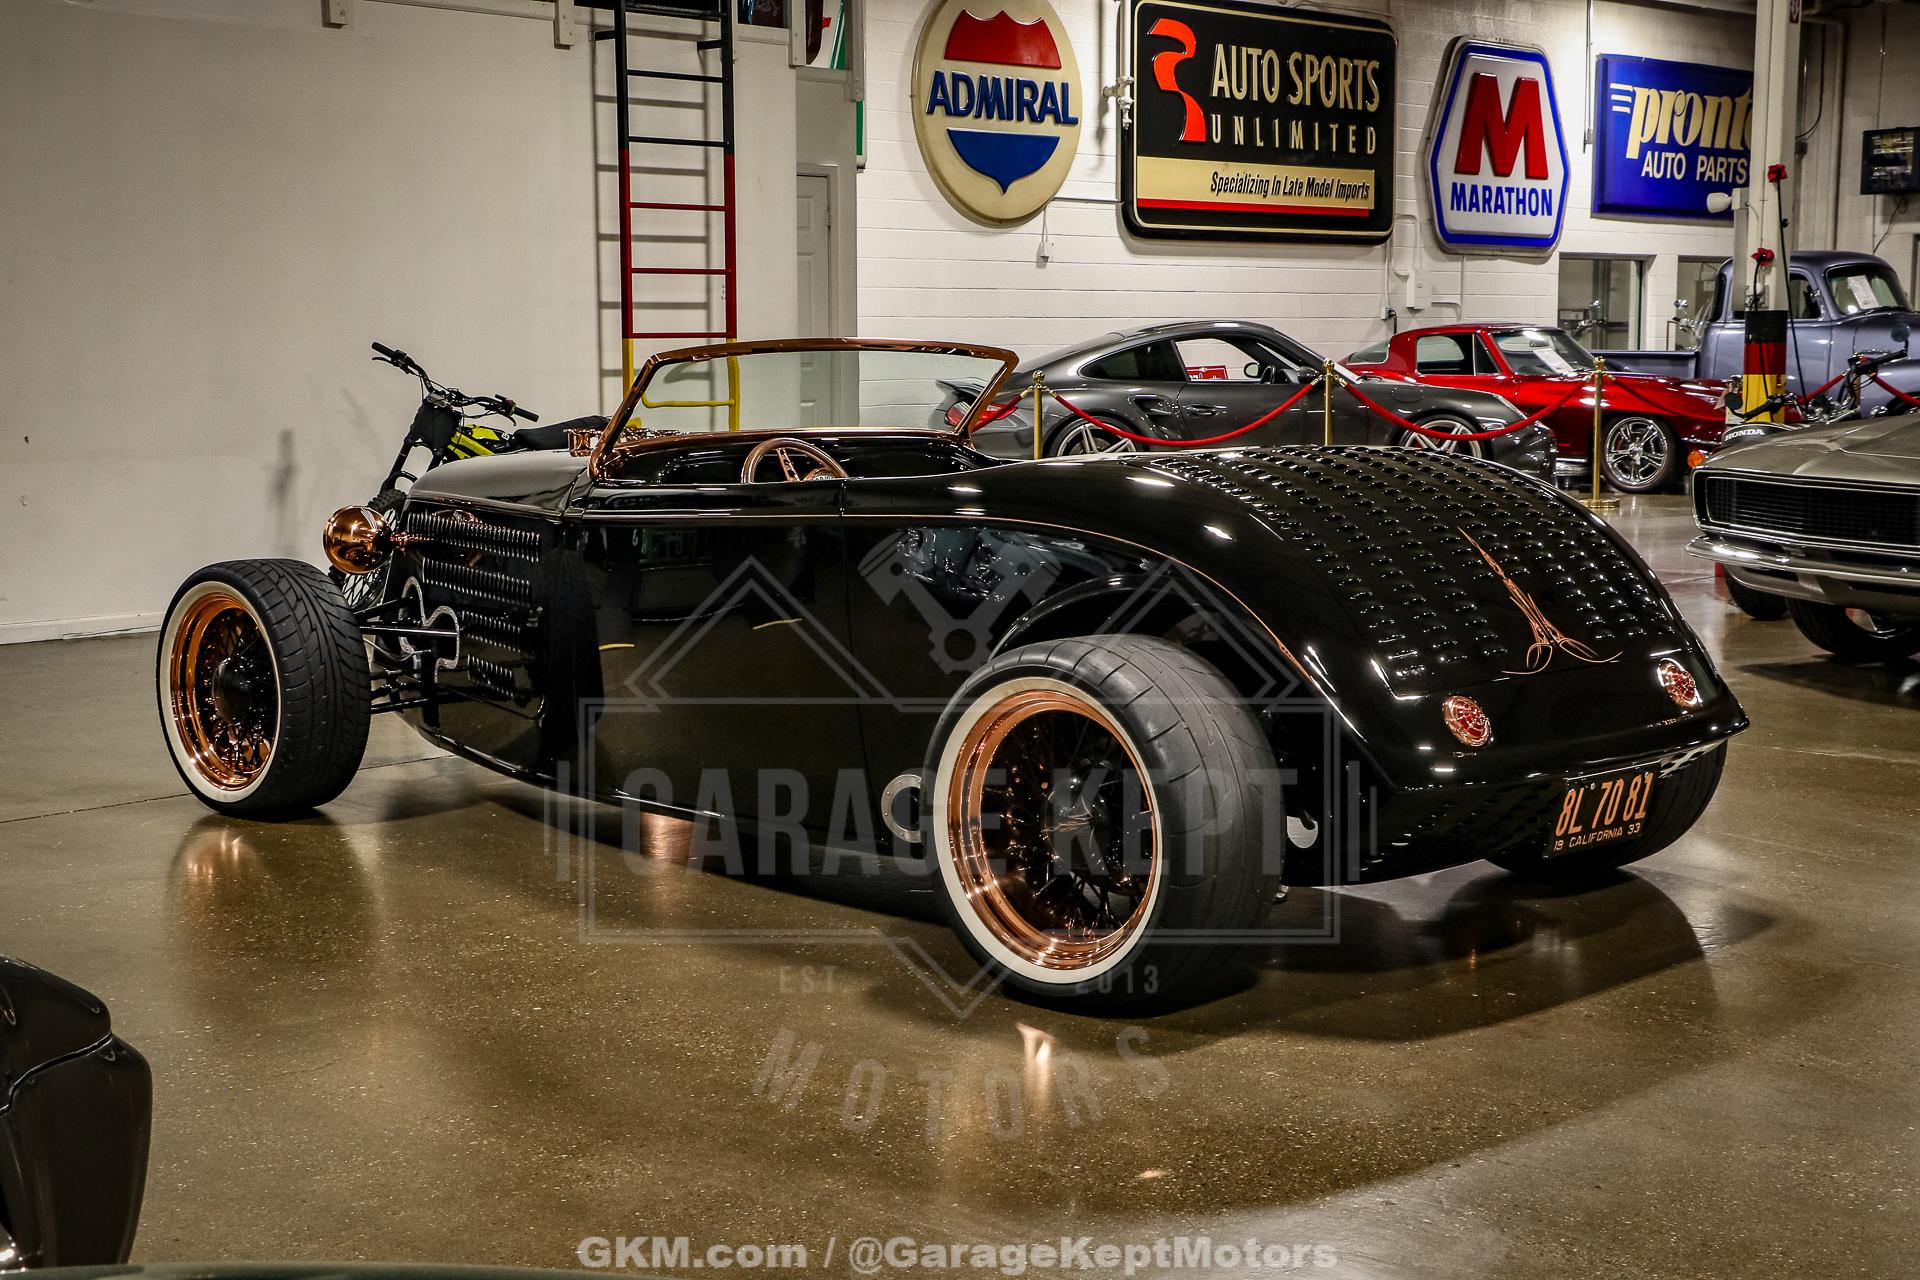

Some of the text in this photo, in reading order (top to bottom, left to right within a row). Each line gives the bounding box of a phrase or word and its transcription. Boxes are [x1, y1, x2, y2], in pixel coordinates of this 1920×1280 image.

[1211, 43, 1380, 112] AUTO SPORTS
[925, 69, 1079, 126] ADMIRAL
[1211, 113, 1377, 155] UNLIMITED
[1454, 72, 1549, 180] M
[1641, 150, 1748, 184] AUTO PARTS
[1210, 171, 1370, 202] Specializing In Late Model Imports
[1450, 182, 1553, 217] MARATHON
[1724, 428, 1766, 441] HONDA
[1555, 772, 1654, 837] 8L 70 81
[1568, 827, 1623, 847] CALIFORNIA
[1627, 822, 1641, 835] 33
